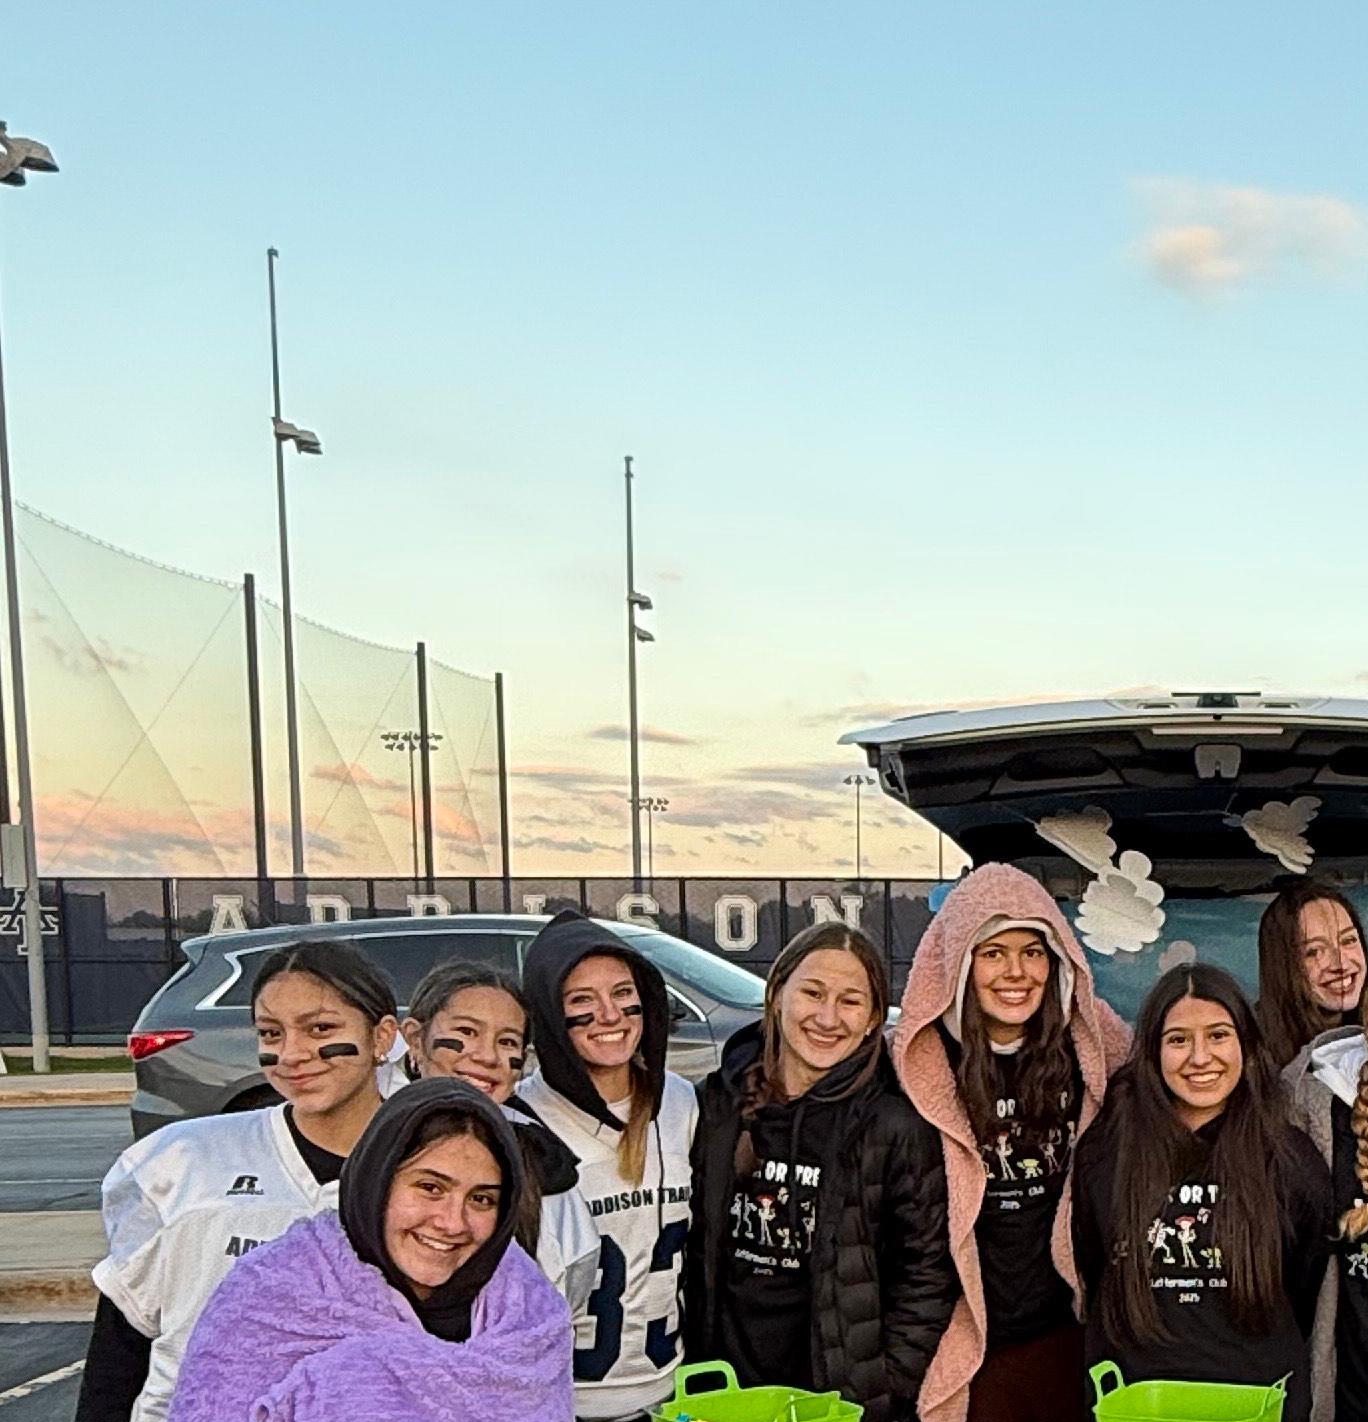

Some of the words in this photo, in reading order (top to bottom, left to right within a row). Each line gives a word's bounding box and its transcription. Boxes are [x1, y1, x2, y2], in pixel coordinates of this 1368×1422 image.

[996, 1098, 1016, 1118] OR
[764, 1160, 788, 1183] OR
[1178, 1184, 1204, 1204] OR
